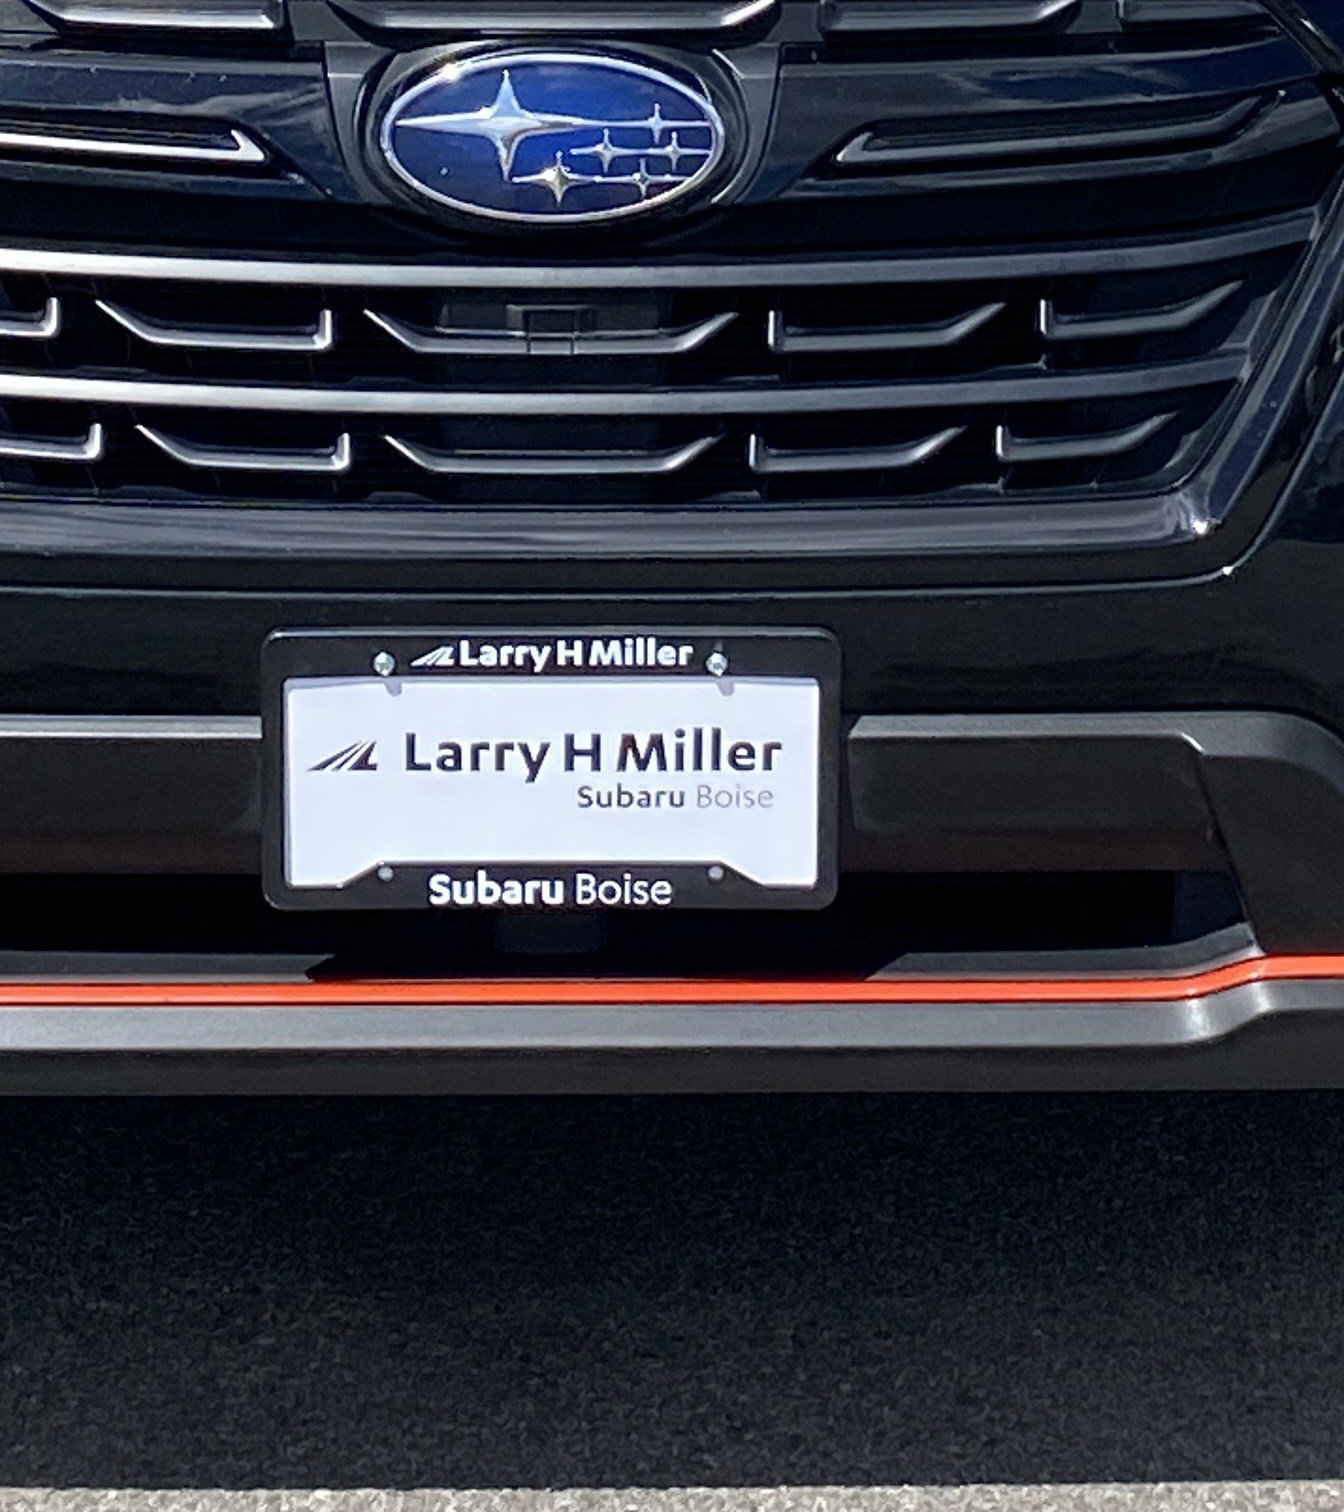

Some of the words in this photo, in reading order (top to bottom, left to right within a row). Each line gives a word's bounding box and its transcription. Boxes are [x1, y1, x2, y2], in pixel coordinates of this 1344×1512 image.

[459, 638, 551, 673] Larry
[556, 639, 583, 666] H
[588, 637, 694, 666] Miller
[405, 731, 552, 784] Larry
[563, 732, 602, 772] H
[615, 726, 783, 772] Miller
[577, 783, 685, 809] Subaru
[696, 784, 775, 809] Boise
[429, 869, 564, 905] Subaru
[575, 873, 673, 905] Boise
